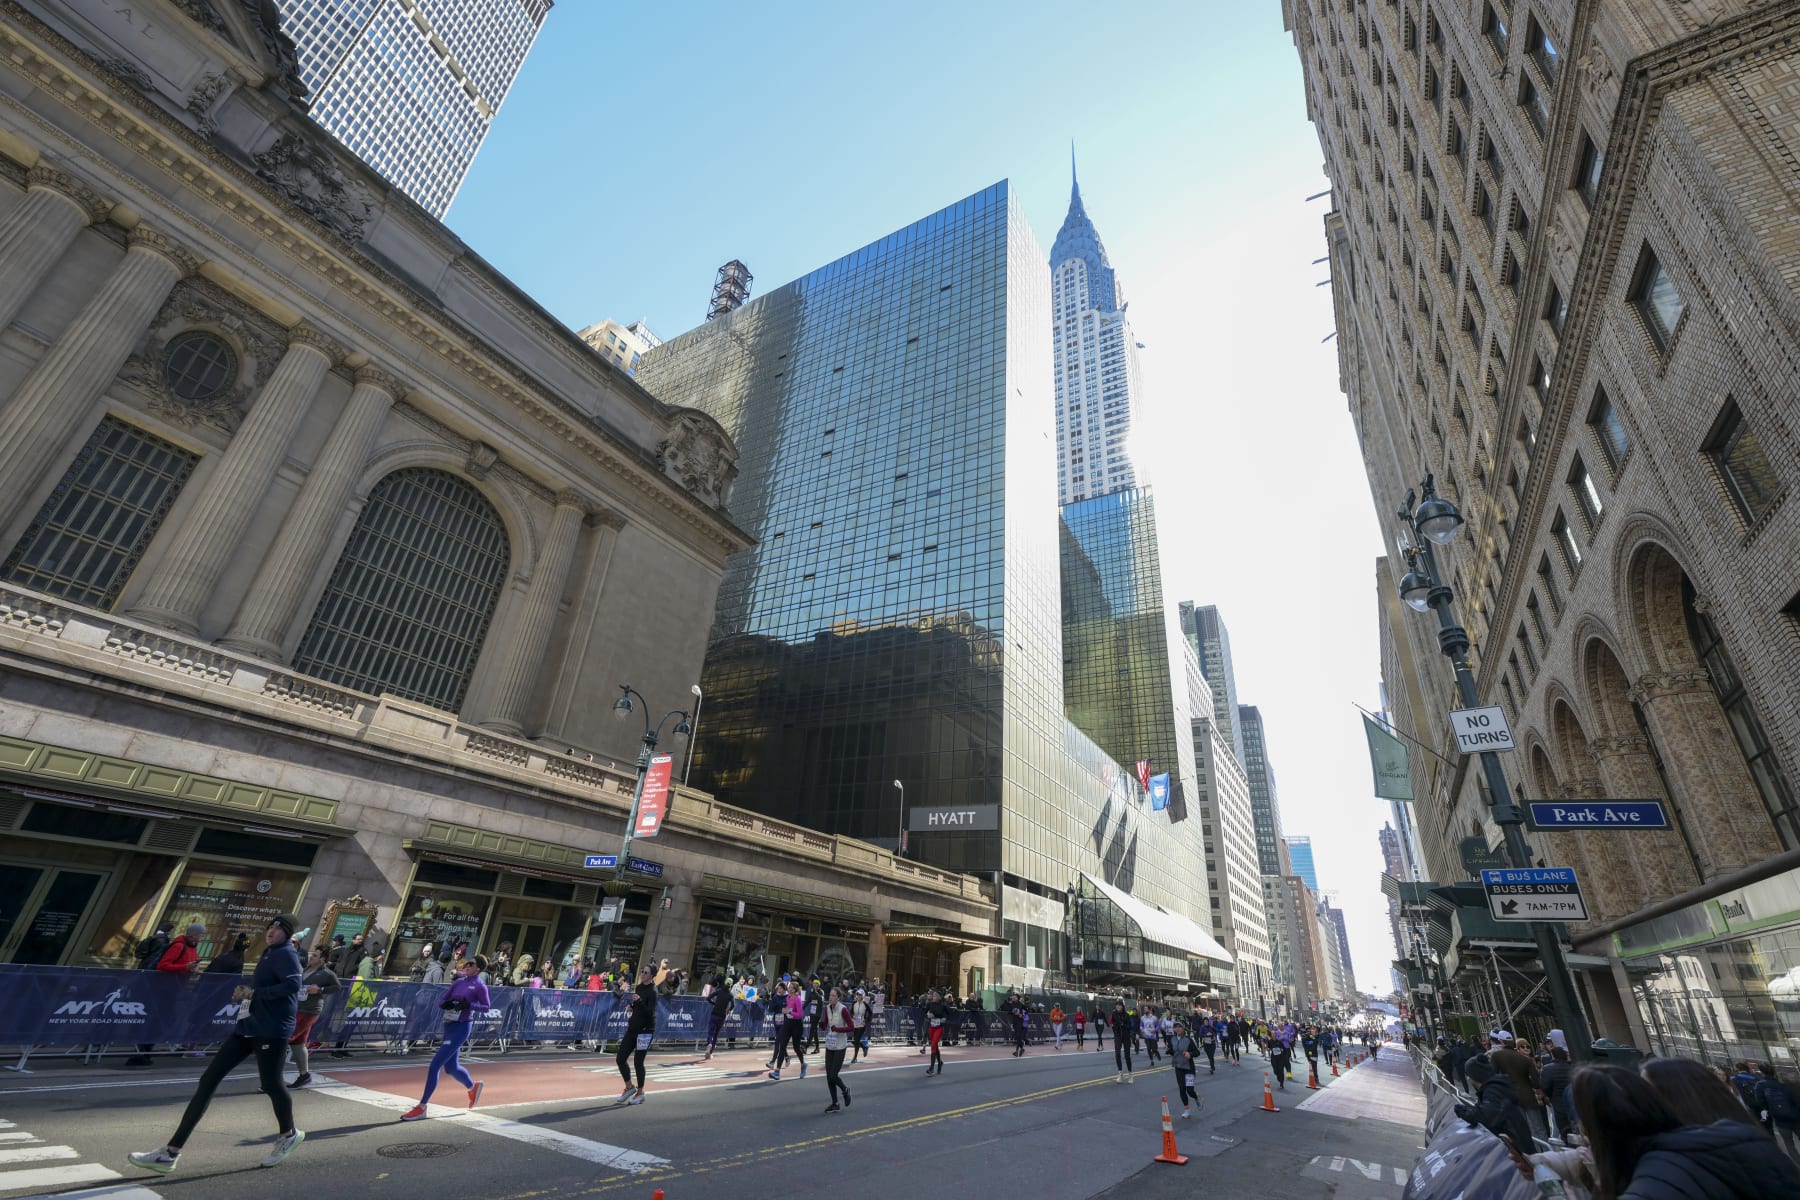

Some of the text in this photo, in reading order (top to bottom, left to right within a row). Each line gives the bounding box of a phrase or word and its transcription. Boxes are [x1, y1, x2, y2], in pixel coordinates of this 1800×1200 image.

[1465, 714, 1490, 728] NO
[1459, 730, 1510, 746] TURNS
[928, 811, 977, 825] HYATT
[1552, 807, 1641, 822] Park Ave
[631, 861, 642, 870] East
[642, 864, 655, 873] 42nd
[1506, 871, 1569, 881] BUS LANE
[1492, 884, 1570, 894] BUSES ONLY
[227, 903, 283, 914] Discover what's
[1525, 902, 1578, 912] 7AM-7PM
[443, 912, 457, 920] For
